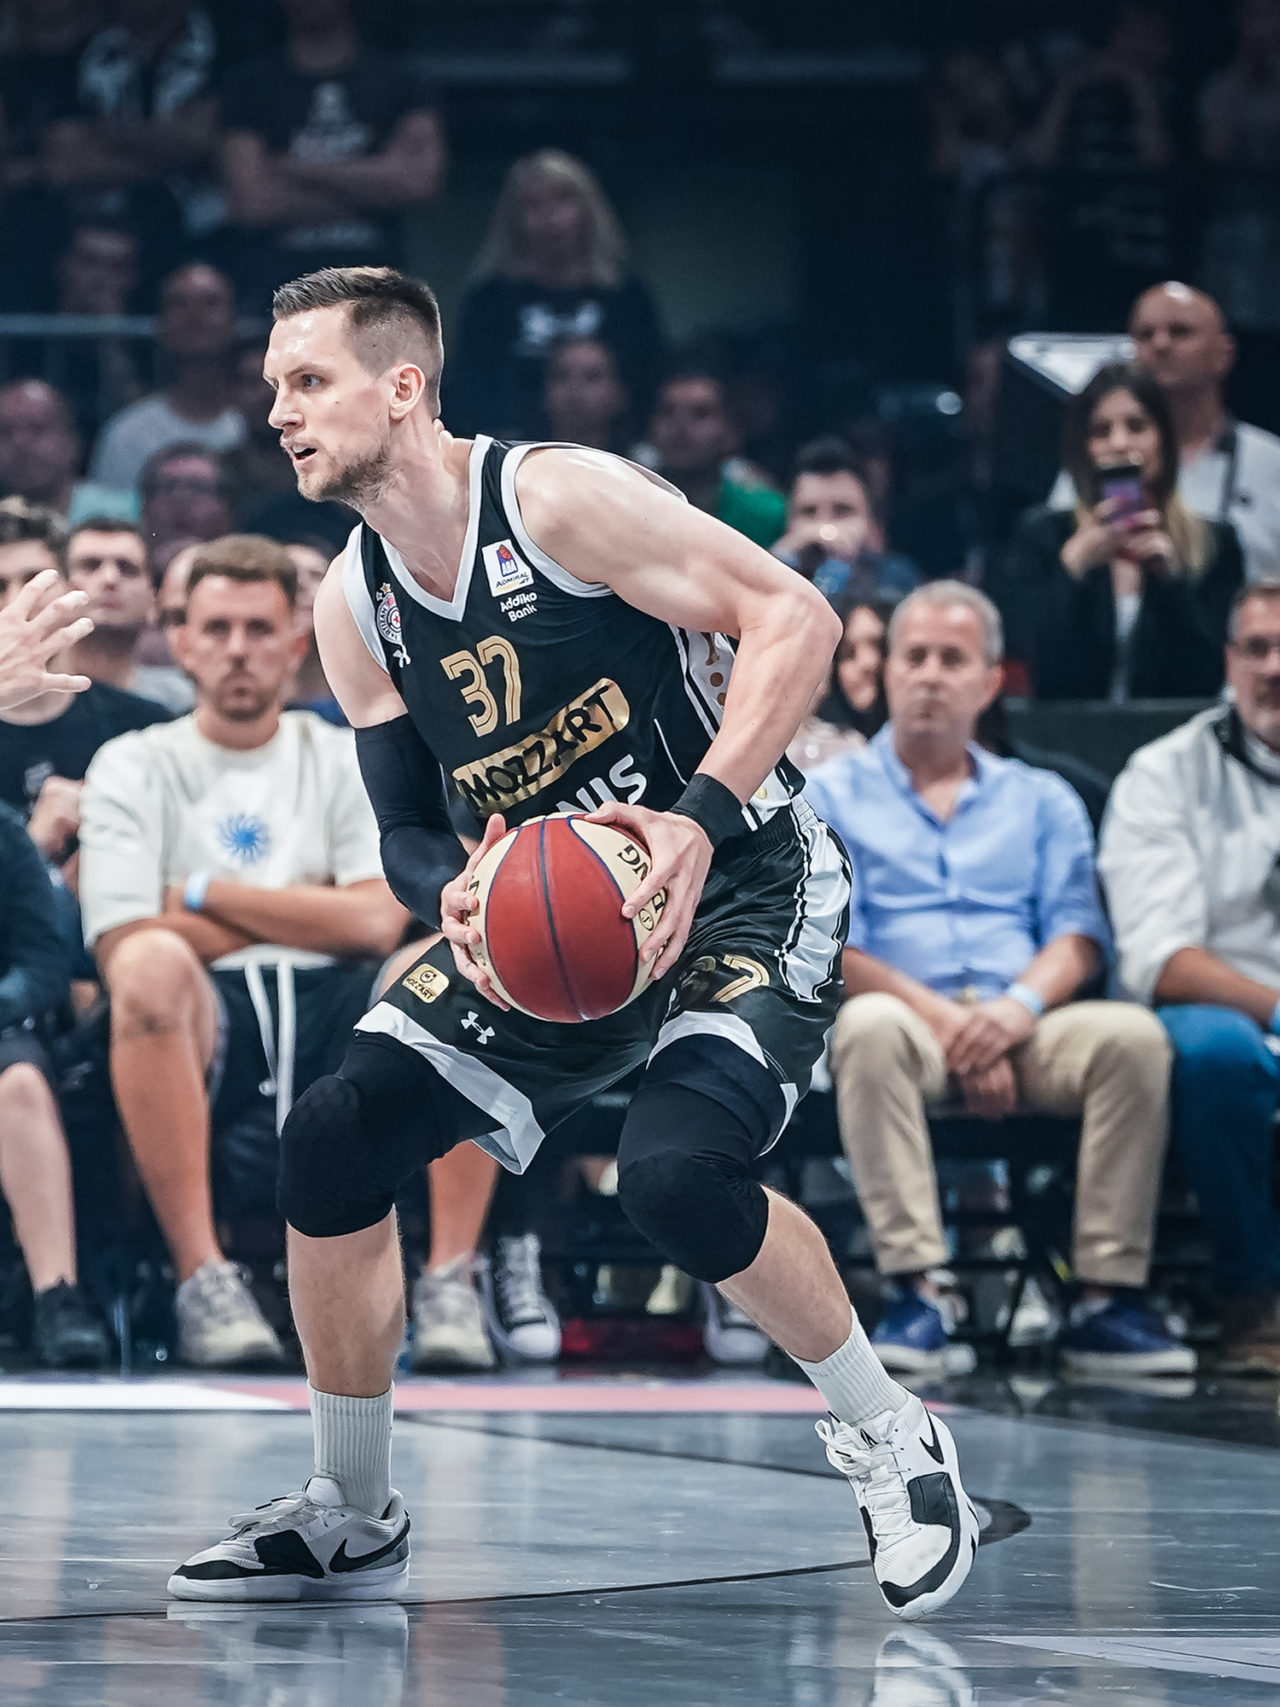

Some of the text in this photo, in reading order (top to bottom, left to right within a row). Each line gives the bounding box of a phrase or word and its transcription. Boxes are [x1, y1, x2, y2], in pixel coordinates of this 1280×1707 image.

[500, 592, 538, 613] Addiko
[508, 604, 538, 622] Bank
[440, 635, 521, 737] 37
